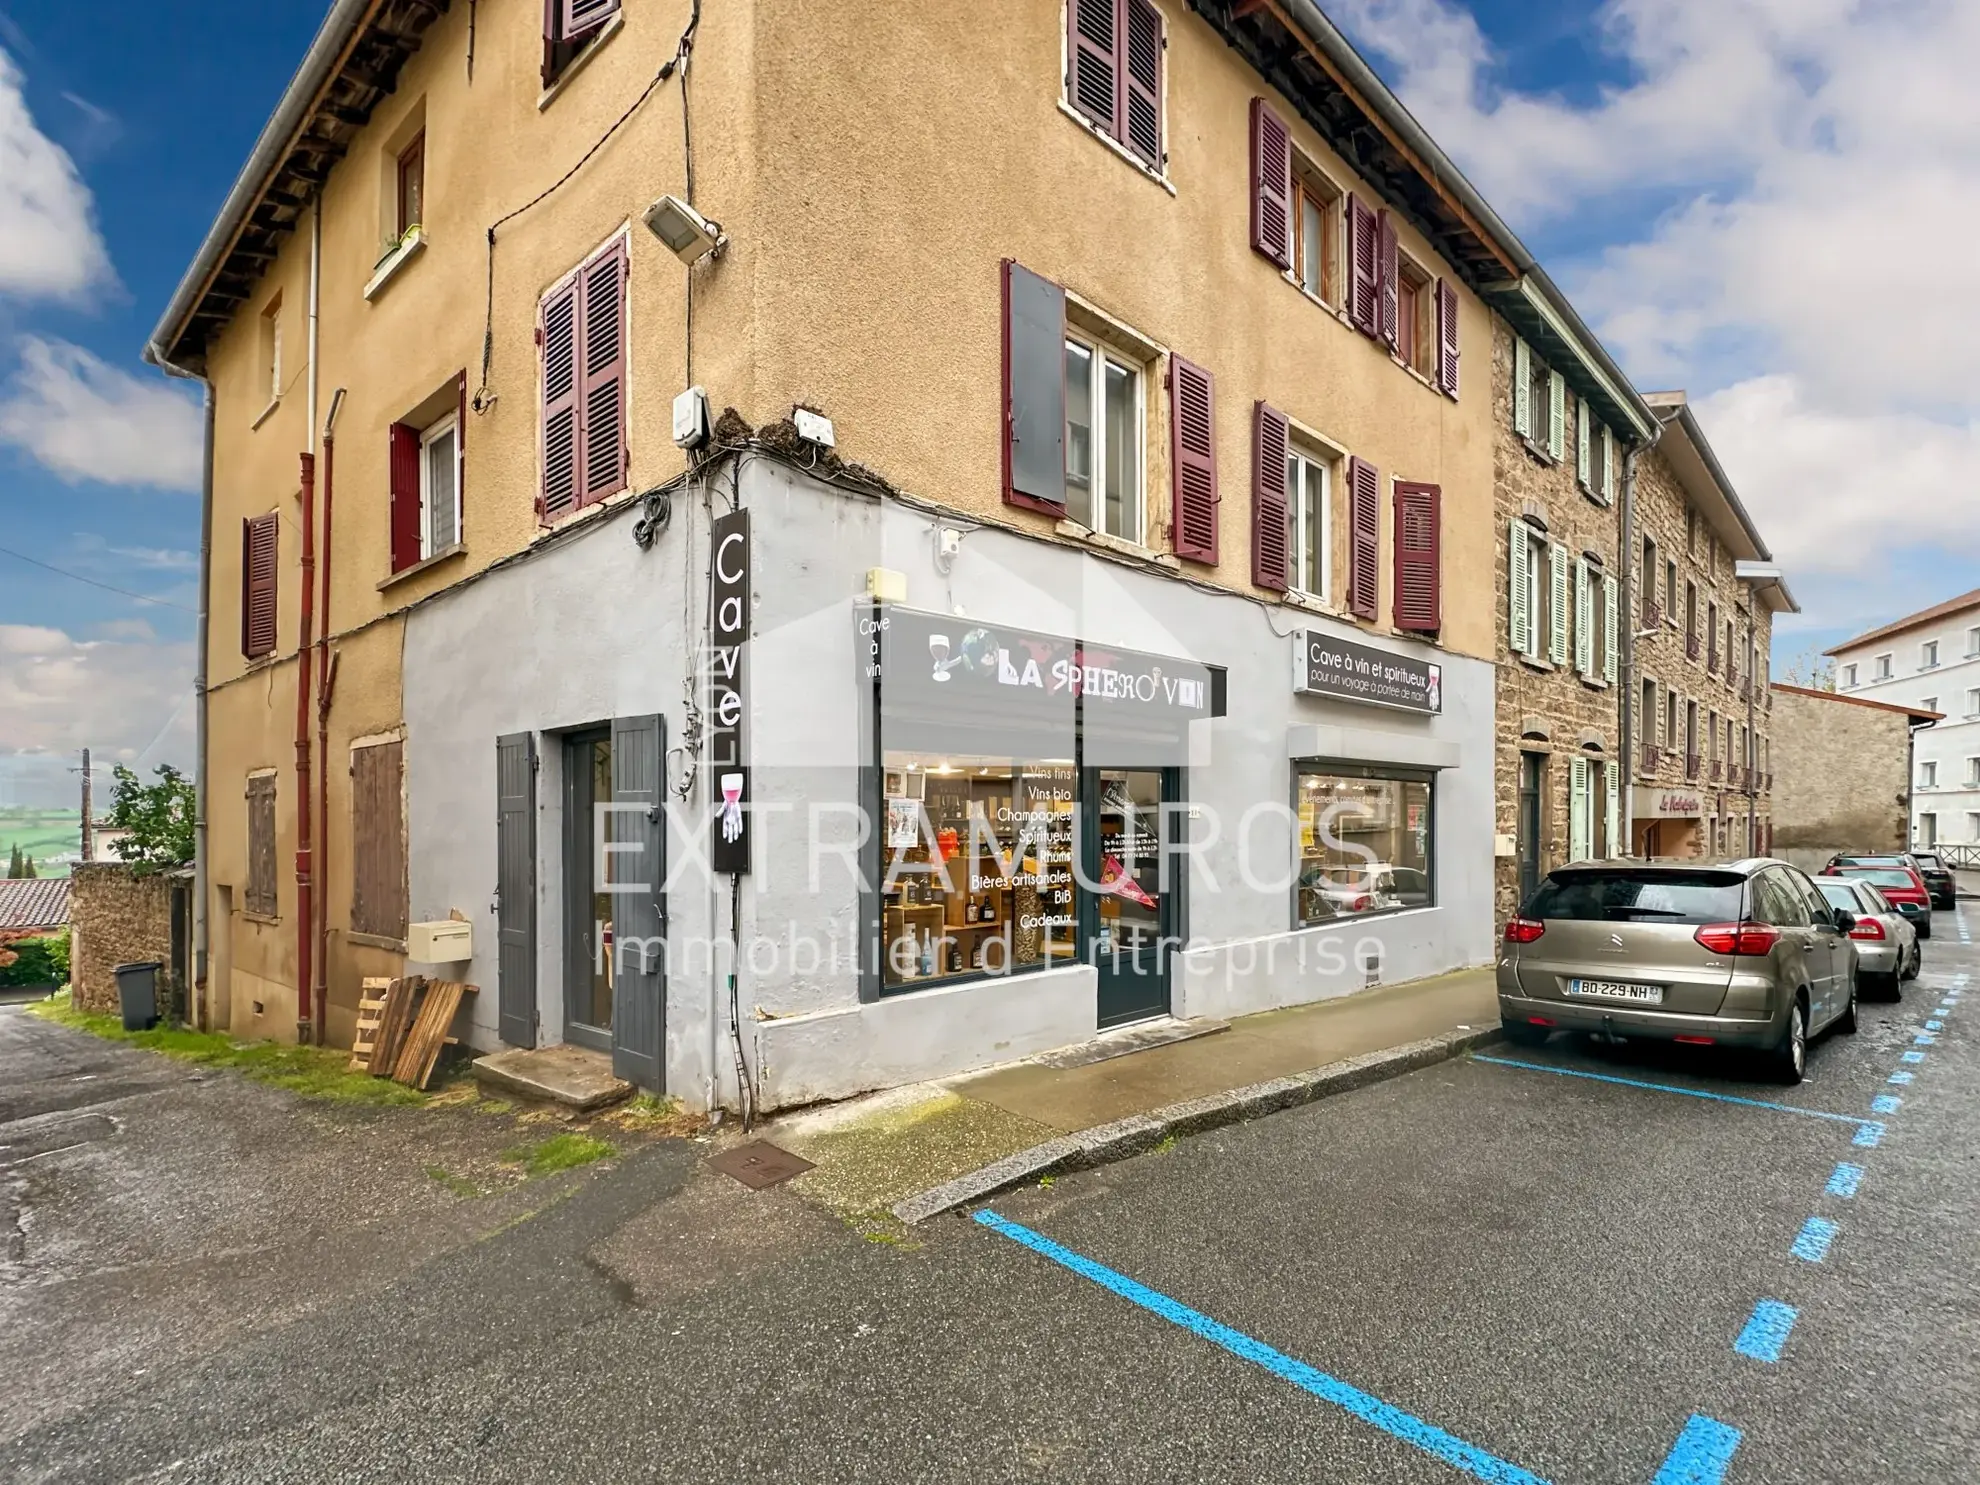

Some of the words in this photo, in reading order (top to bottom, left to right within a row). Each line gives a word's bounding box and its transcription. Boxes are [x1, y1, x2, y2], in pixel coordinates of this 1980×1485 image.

[716, 532, 744, 727] Cave
[859, 617, 890, 635] Cave
[869, 639, 879, 655] à
[865, 662, 881, 678] vin
[998, 648, 1043, 688] LA
[1310, 643, 1342, 669] Cave
[1344, 653, 1353, 672] à
[1354, 657, 1370, 676] vin
[1371, 661, 1382, 678] et
[1384, 666, 1426, 688] spiritueux
[1310, 669, 1330, 683] pour
[1330, 672, 1341, 684] un
[1341, 675, 1370, 692] voyage
[1370, 681, 1377, 689] à
[1400, 686, 1411, 700] de
[1029, 765, 1052, 779] Vins
[1054, 768, 1071, 780] fins
[1028, 786, 1051, 801] Vins
[1053, 787, 1072, 801] bio
[997, 807, 1072, 823] Champagnes
[1019, 829, 1072, 845] Spiritueux
[971, 874, 1009, 891] Bières
[1012, 869, 1072, 886] artisanales
[1054, 890, 1072, 904] BiB
[1020, 912, 1072, 929] Cadeaux
